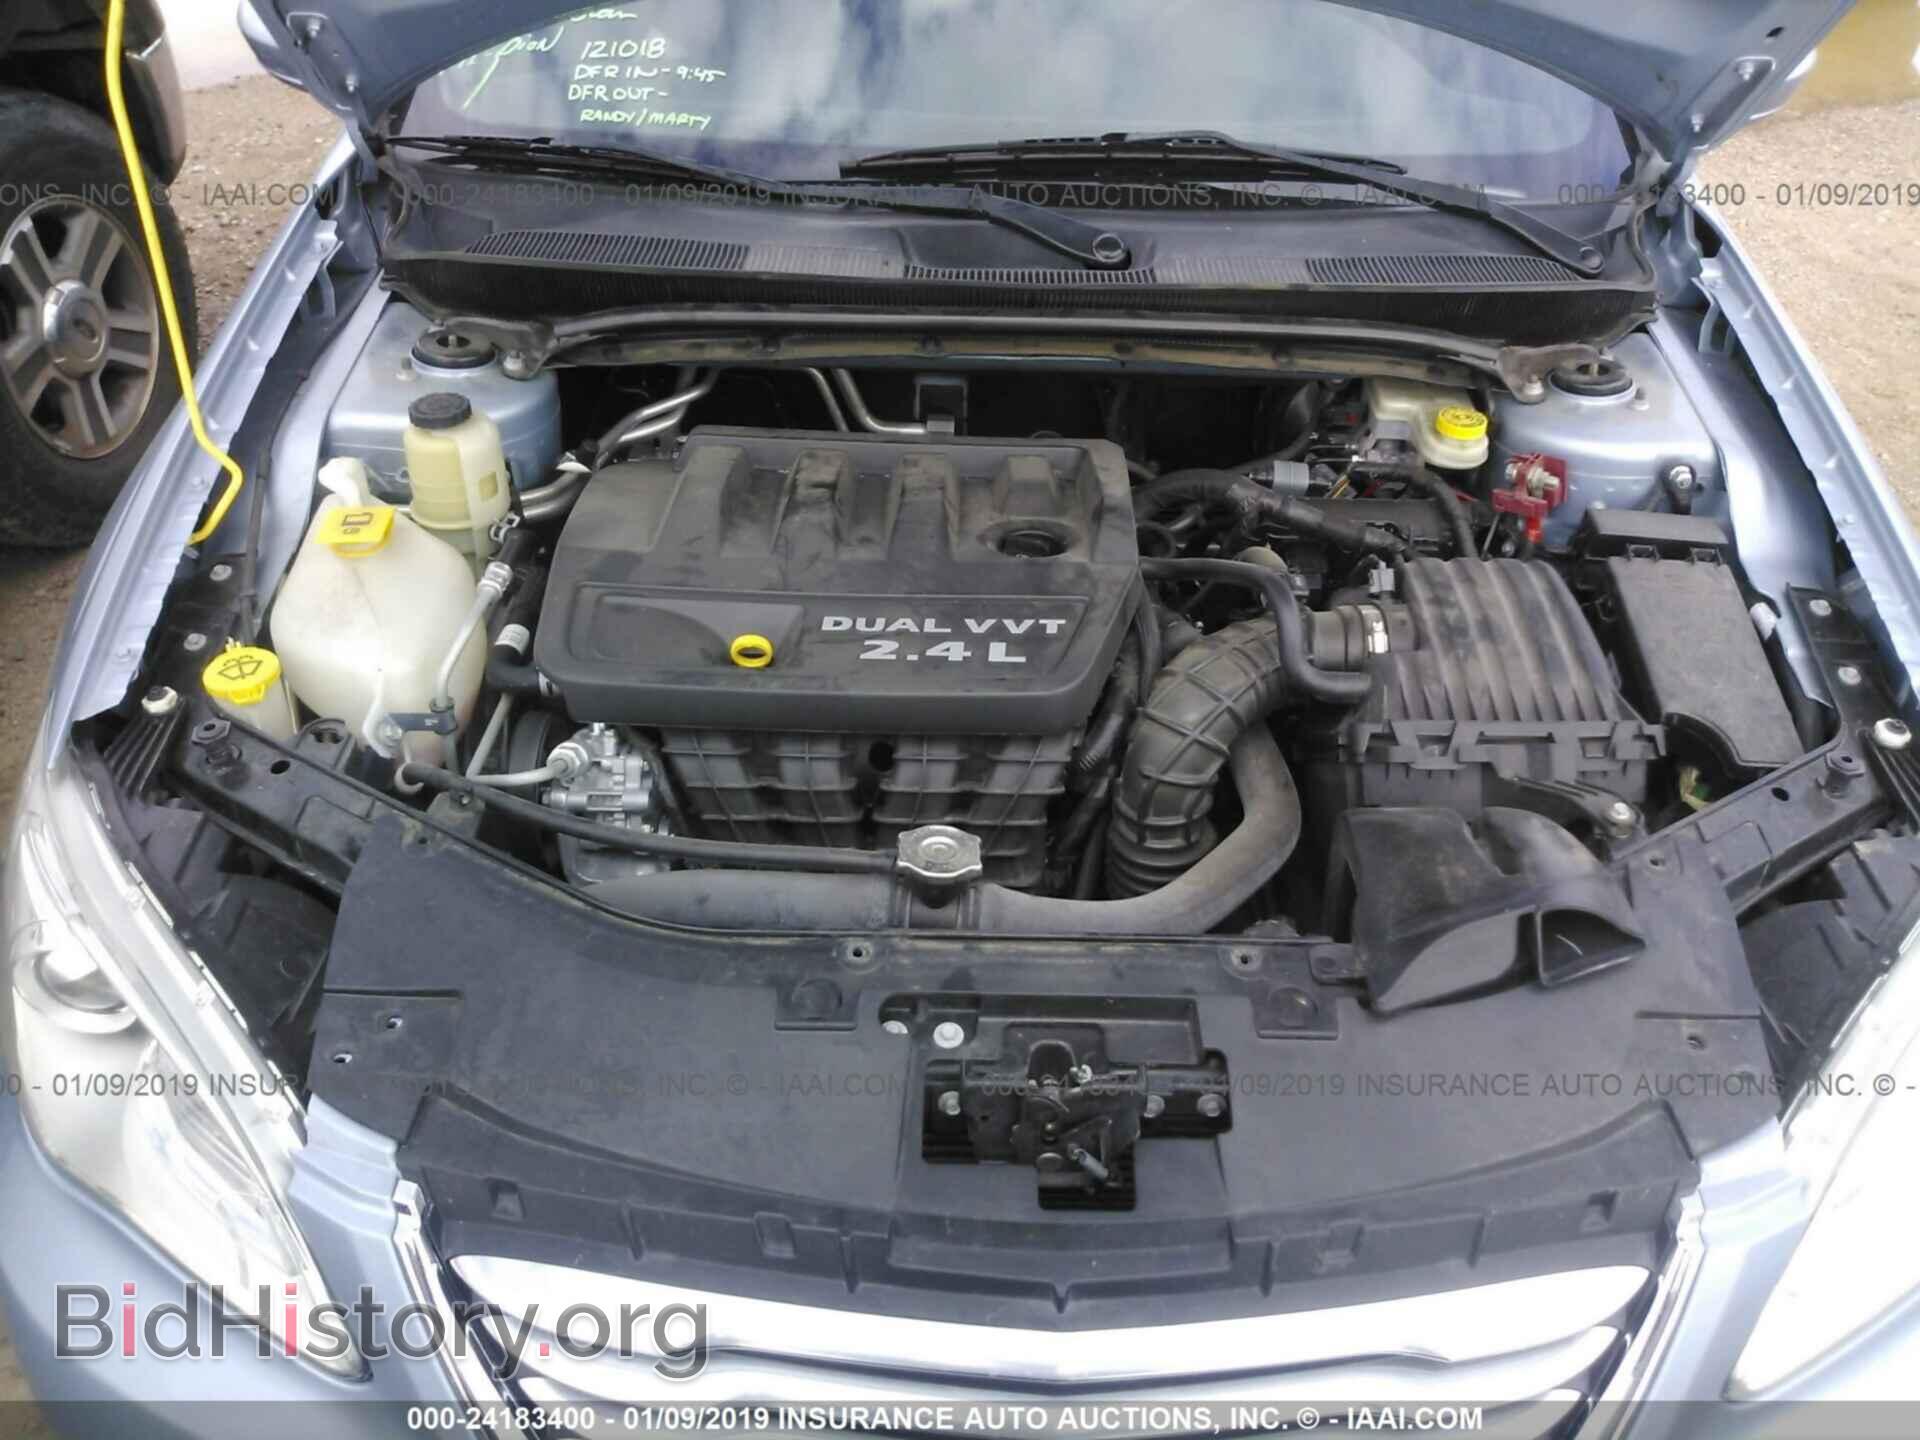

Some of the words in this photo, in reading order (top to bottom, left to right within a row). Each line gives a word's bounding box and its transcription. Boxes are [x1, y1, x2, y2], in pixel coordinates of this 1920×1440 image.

[580, 37, 666, 60] 121018
[574, 64, 619, 80] DFR
[567, 84, 610, 101] DFR
[821, 616, 952, 633] DUAL
[964, 618, 1067, 634] VVT
